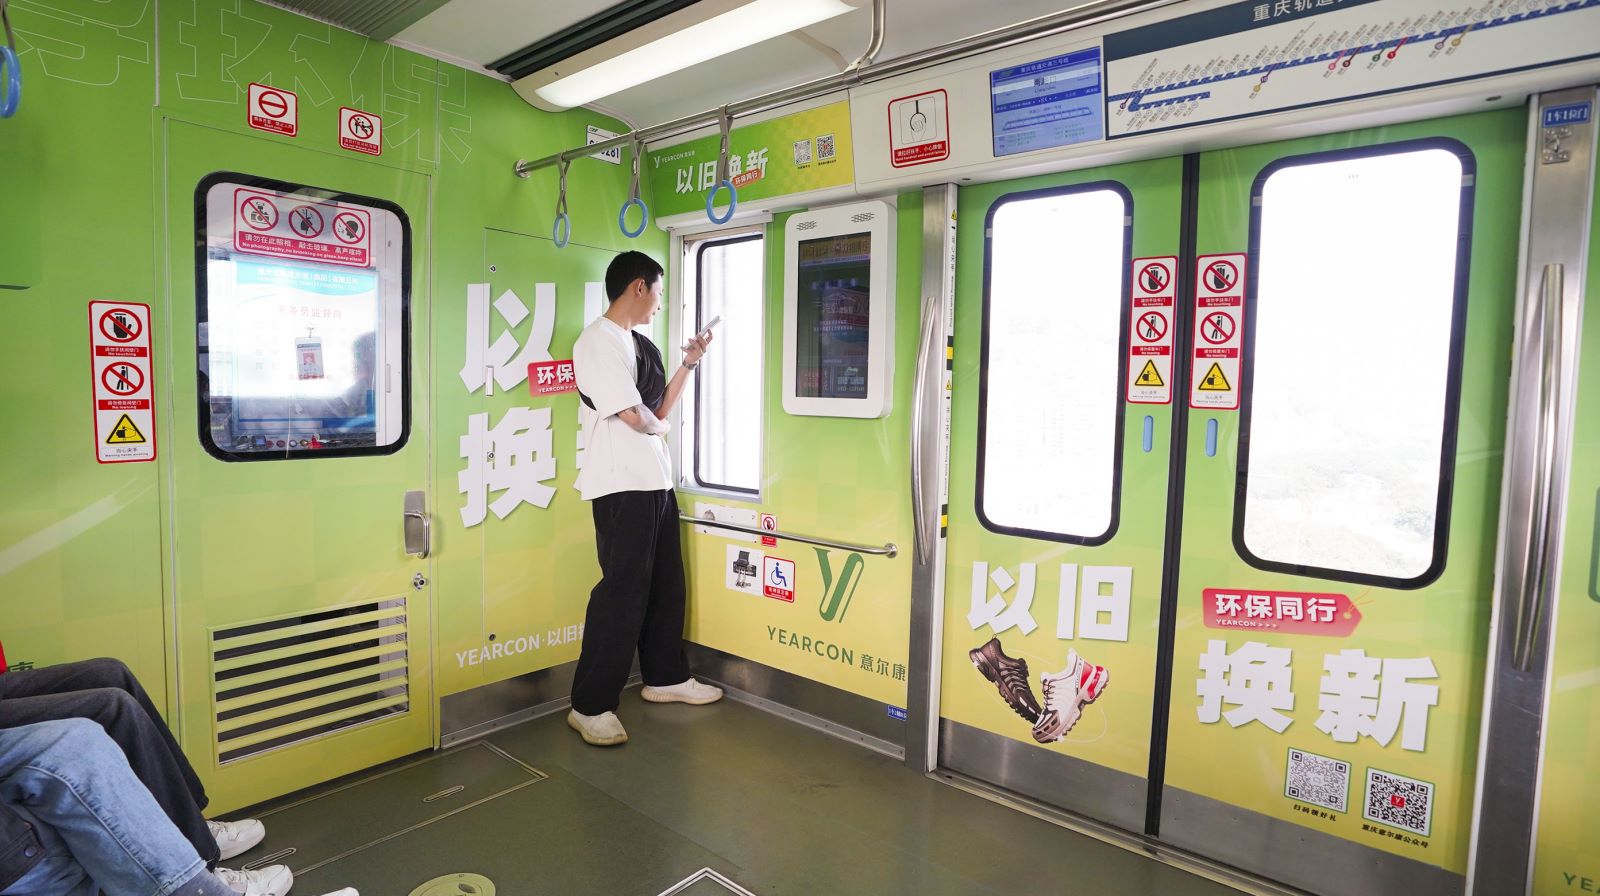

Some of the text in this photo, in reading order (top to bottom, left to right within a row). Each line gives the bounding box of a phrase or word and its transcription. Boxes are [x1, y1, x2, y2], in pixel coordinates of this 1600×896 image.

[1253, 0, 1340, 22] 重庆轨
[661, 153, 684, 163] YEARCON
[537, 363, 574, 385] 环保
[457, 406, 586, 527] 换
[966, 561, 1133, 643] 以旧
[1215, 593, 1337, 623] 环保同行
[1216, 618, 1257, 627] YEARCON
[767, 625, 907, 682] YEARCON 意尔康
[1196, 639, 1440, 752] 换新
[1293, 803, 1337, 822] 扫码领好礼
[1361, 823, 1430, 849] 重庆意尔康公众号
[1563, 871, 1600, 894] YE
